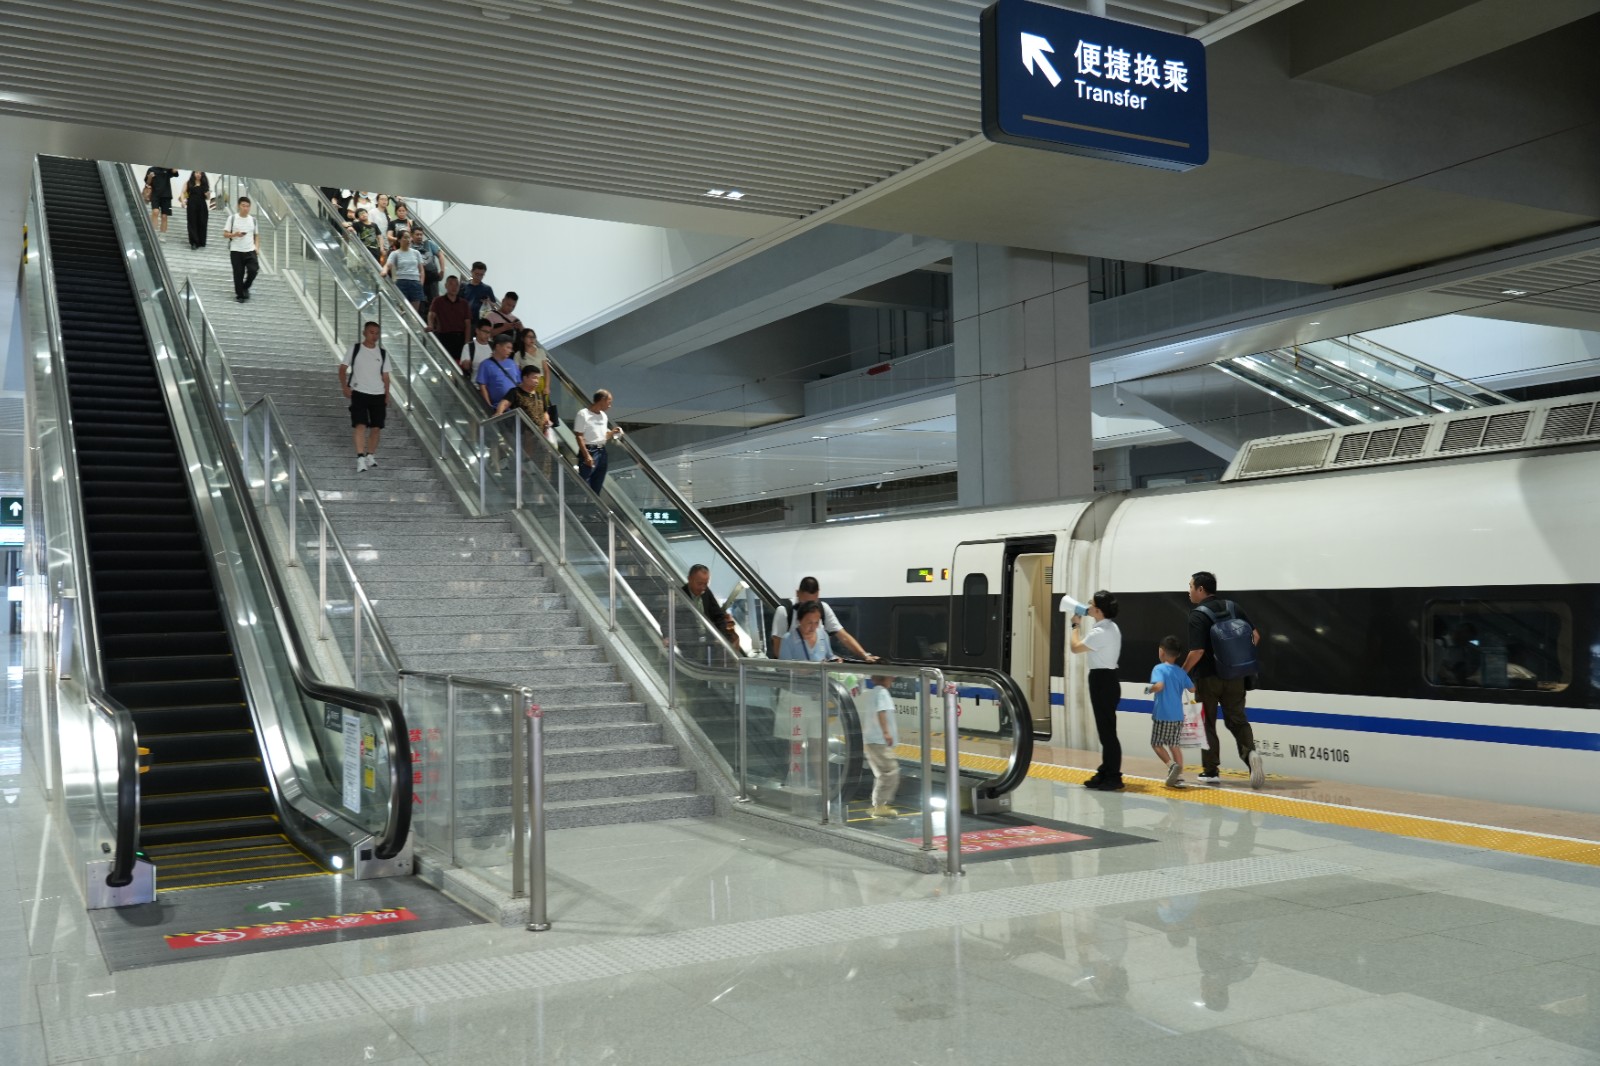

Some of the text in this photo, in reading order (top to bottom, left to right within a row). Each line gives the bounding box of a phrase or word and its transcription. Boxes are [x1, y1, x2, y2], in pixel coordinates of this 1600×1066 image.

[1073, 39, 1189, 93] 便捷换乘
[1073, 79, 1147, 110] Transfer
[1289, 744, 1306, 758] WR
[1310, 746, 1350, 763] 246106
